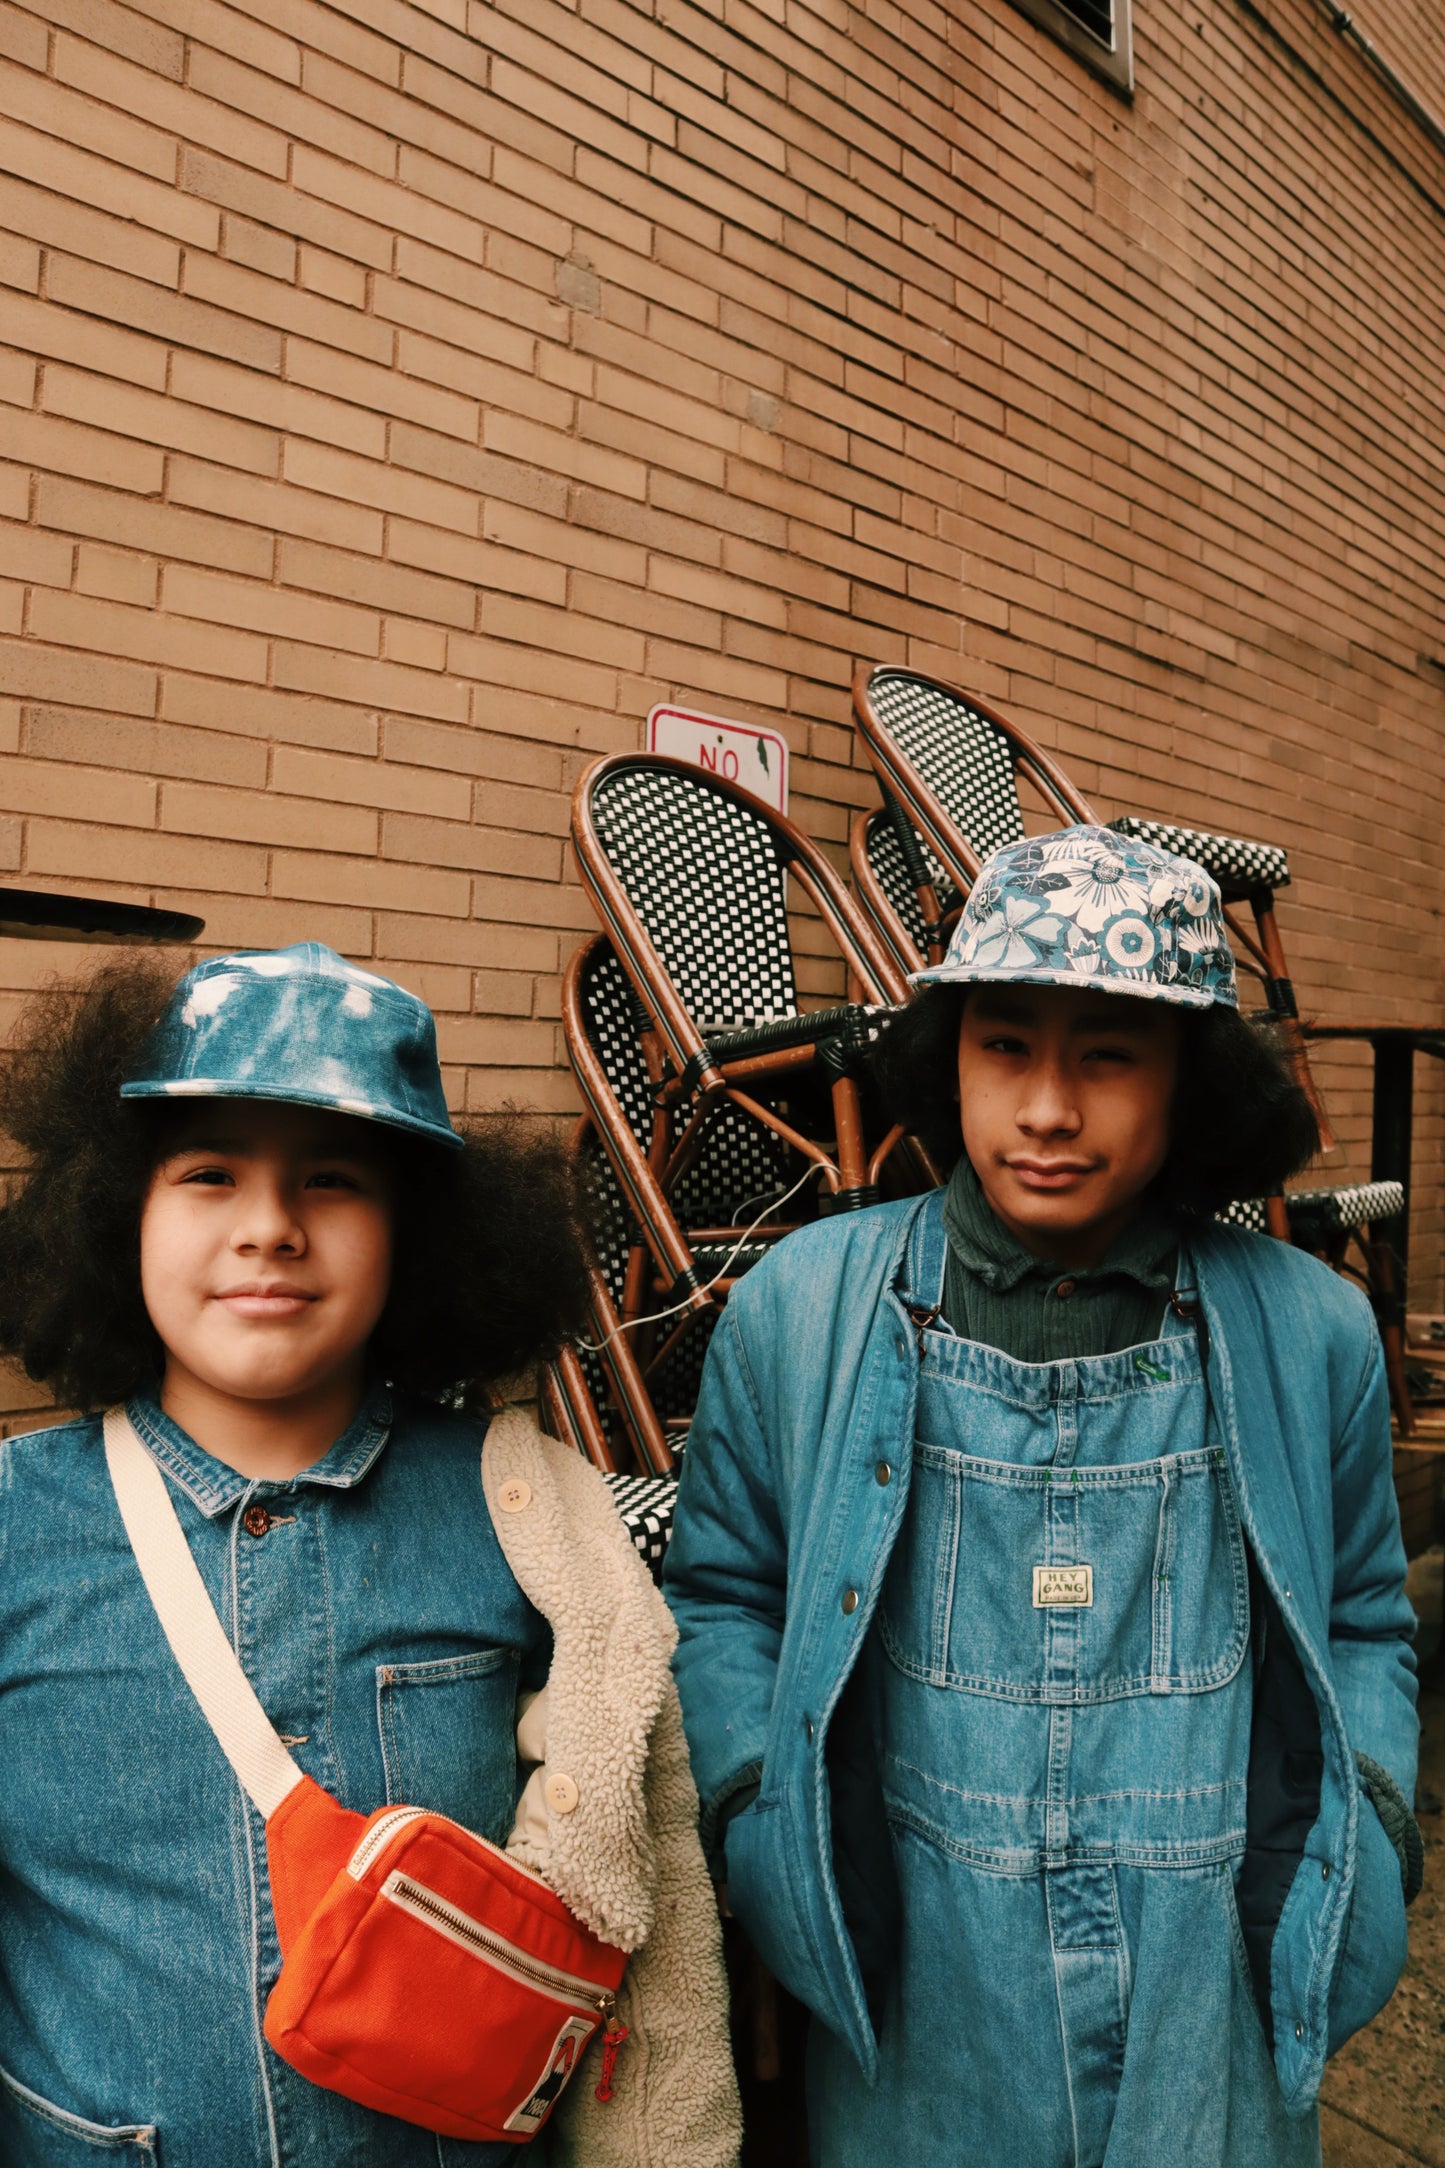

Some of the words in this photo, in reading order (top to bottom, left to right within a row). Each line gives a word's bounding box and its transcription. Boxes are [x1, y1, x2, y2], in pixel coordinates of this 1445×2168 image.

[700, 744, 739, 781] NO
[1048, 1573, 1077, 1582] HEY
[1043, 1583, 1084, 1594] GANG
